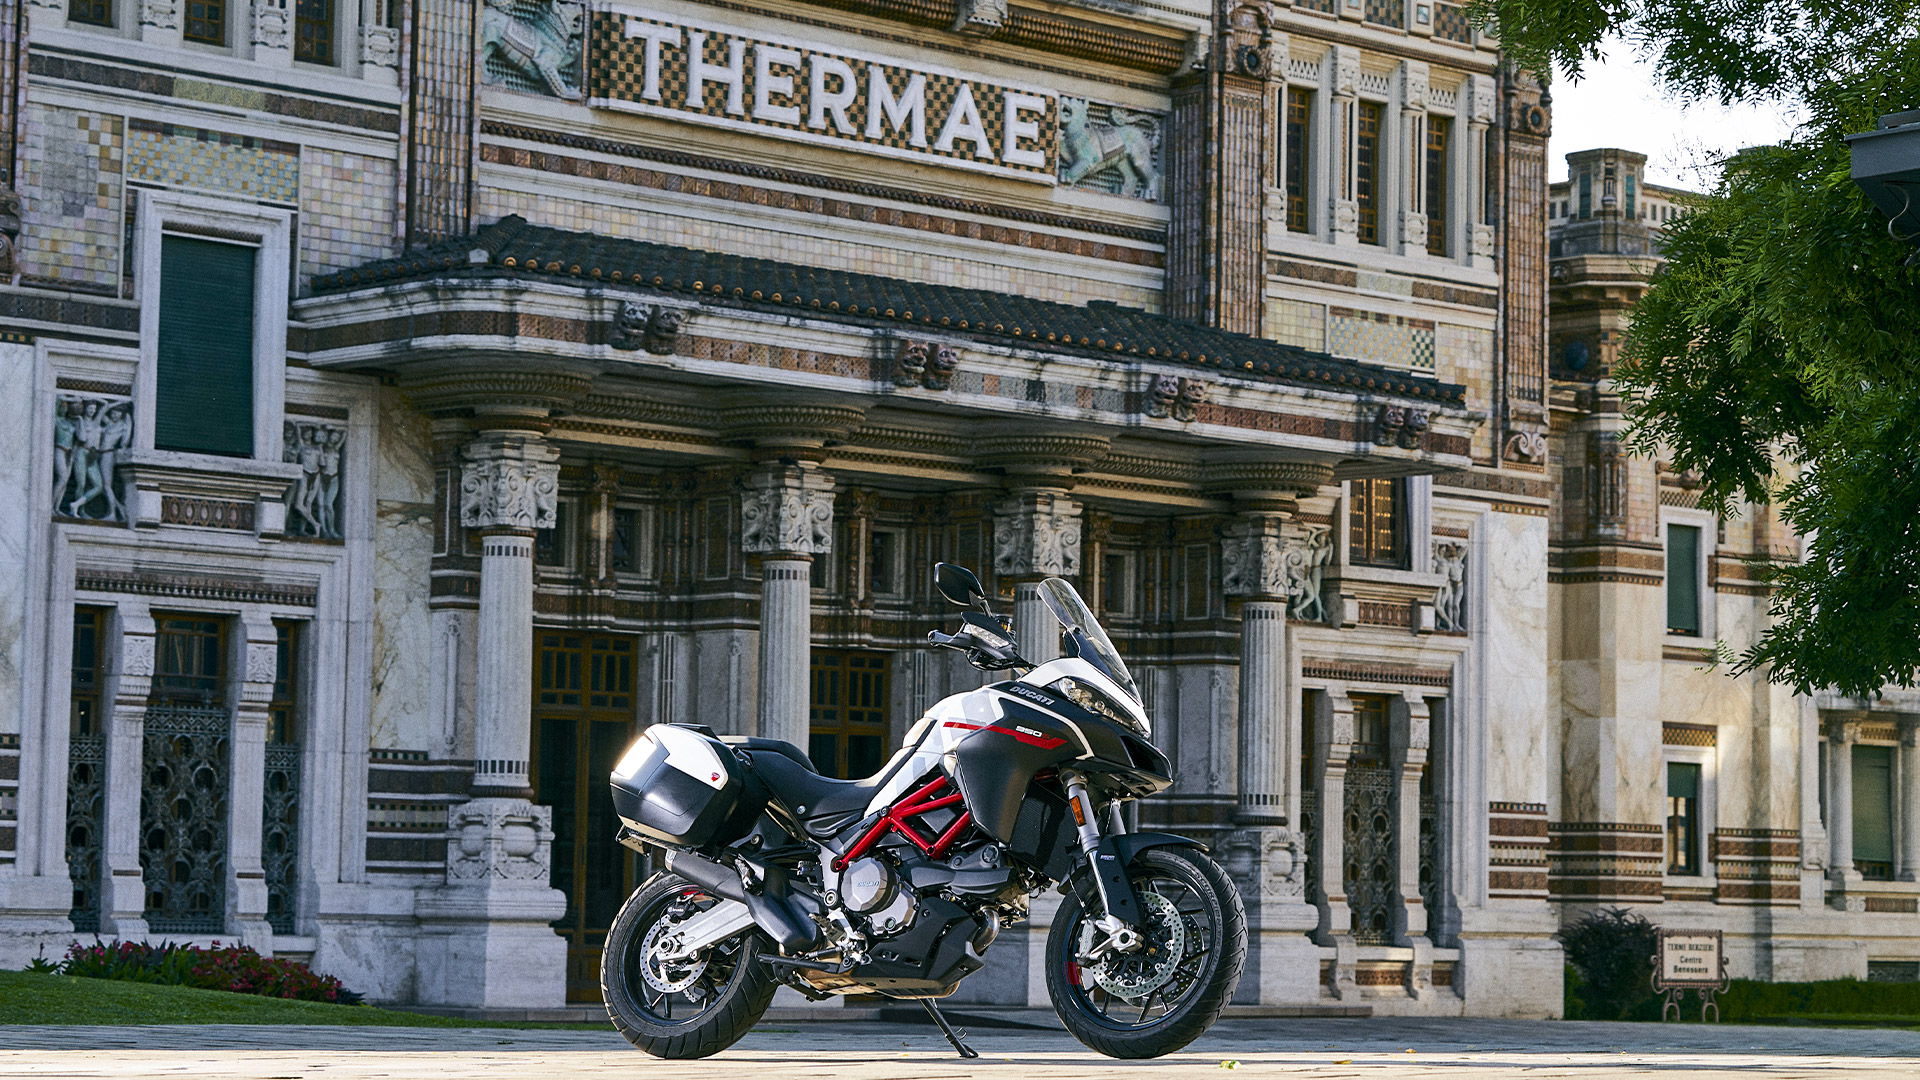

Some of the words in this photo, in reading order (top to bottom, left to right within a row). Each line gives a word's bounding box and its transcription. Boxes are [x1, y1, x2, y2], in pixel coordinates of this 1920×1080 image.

[623, 18, 1048, 168] THERMAE
[1009, 686, 1055, 705] DUCATI
[1680, 955, 1702, 963] Centro
[1673, 965, 1708, 973] Benessere
